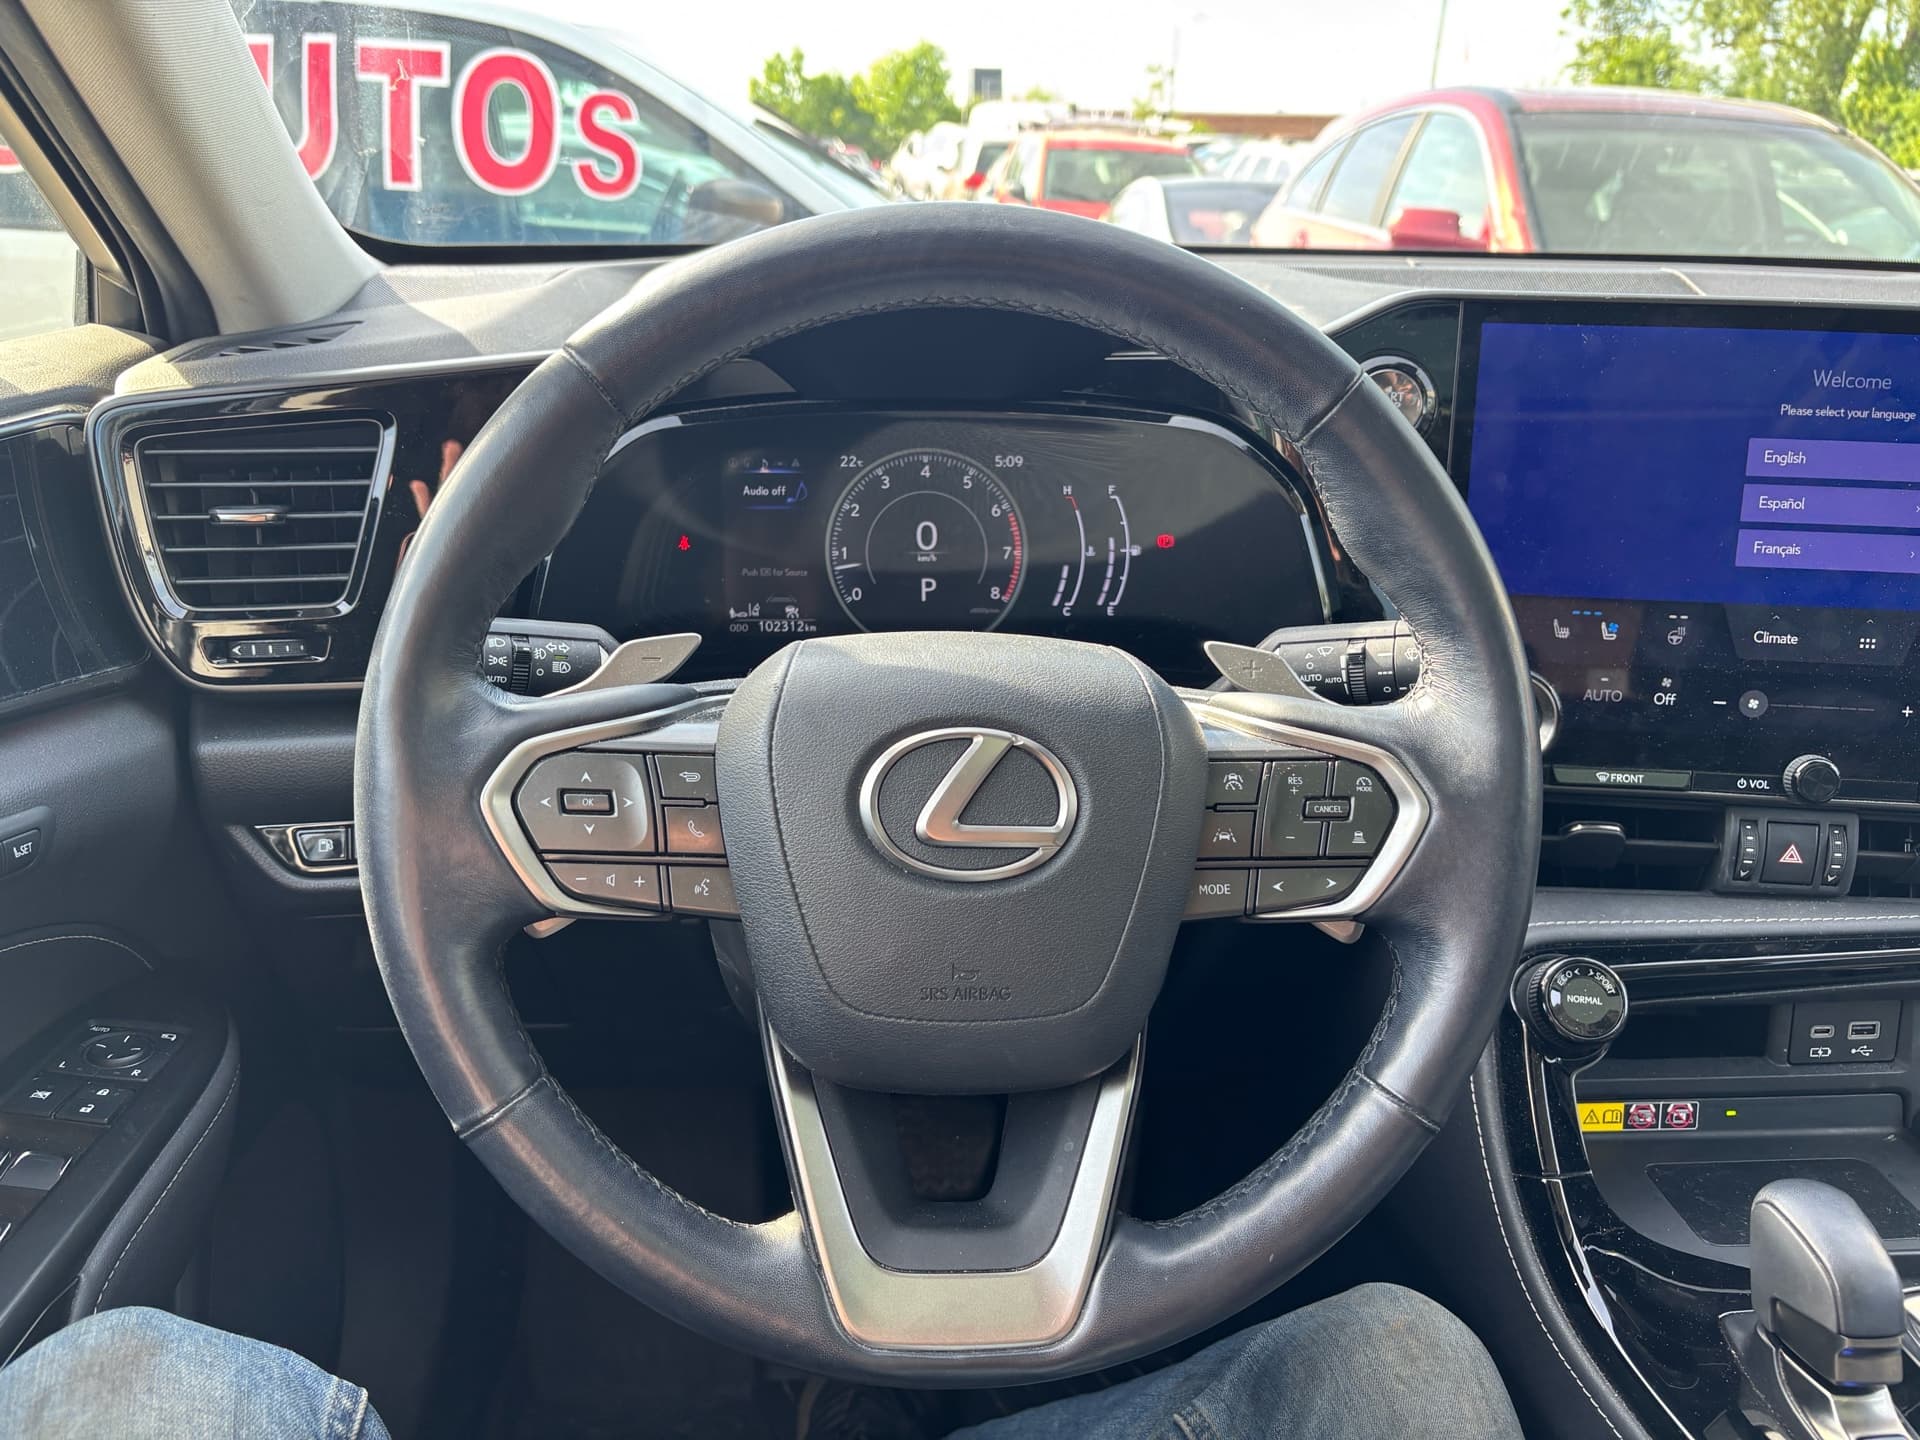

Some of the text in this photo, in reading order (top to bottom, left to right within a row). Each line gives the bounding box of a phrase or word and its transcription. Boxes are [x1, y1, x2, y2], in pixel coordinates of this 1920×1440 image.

[1812, 369, 1893, 390] Welcome
[1780, 403, 1917, 423] Please select your language
[994, 455, 1024, 468] 5:09
[1764, 449, 1807, 467] English
[920, 465, 931, 478] 4
[881, 475, 890, 489] 3
[963, 475, 972, 489] 5
[743, 485, 786, 497] Audio off
[1062, 485, 1073, 495] H
[1108, 485, 1117, 495] F
[850, 503, 860, 517] 2
[991, 503, 1001, 517] 6
[1759, 495, 1806, 512] Español
[916, 521, 938, 551] 0
[841, 546, 848, 560] 1
[1003, 546, 1012, 560] 7
[1753, 540, 1801, 558] Français
[741, 567, 759, 577] Push
[851, 587, 862, 601] 0
[920, 577, 937, 602] P
[990, 587, 1001, 601] 8
[1062, 606, 1071, 617] C
[1106, 606, 1115, 617] E
[729, 623, 749, 632] ODO
[1753, 630, 1798, 646] Climate
[1300, 673, 1322, 682] AUTO
[1324, 676, 1342, 684] AUTO
[1583, 688, 1623, 703] AUTO
[1653, 692, 1677, 706] Off
[1287, 776, 1303, 785] RES
[1610, 773, 1645, 785] FRONT
[1749, 780, 1771, 790] VOL
[582, 797, 594, 807] OK
[1313, 805, 1343, 813] CANCEL
[1199, 884, 1231, 895] MODE
[1557, 970, 1573, 986] ECO
[1594, 972, 1616, 994] SPORT
[920, 987, 1013, 1001] SRS AIRBAG
[1567, 994, 1603, 1006] NORMAL
[89, 1024, 111, 1033] AUTO
[58, 1060, 66, 1068] L
[130, 1069, 142, 1077] R
